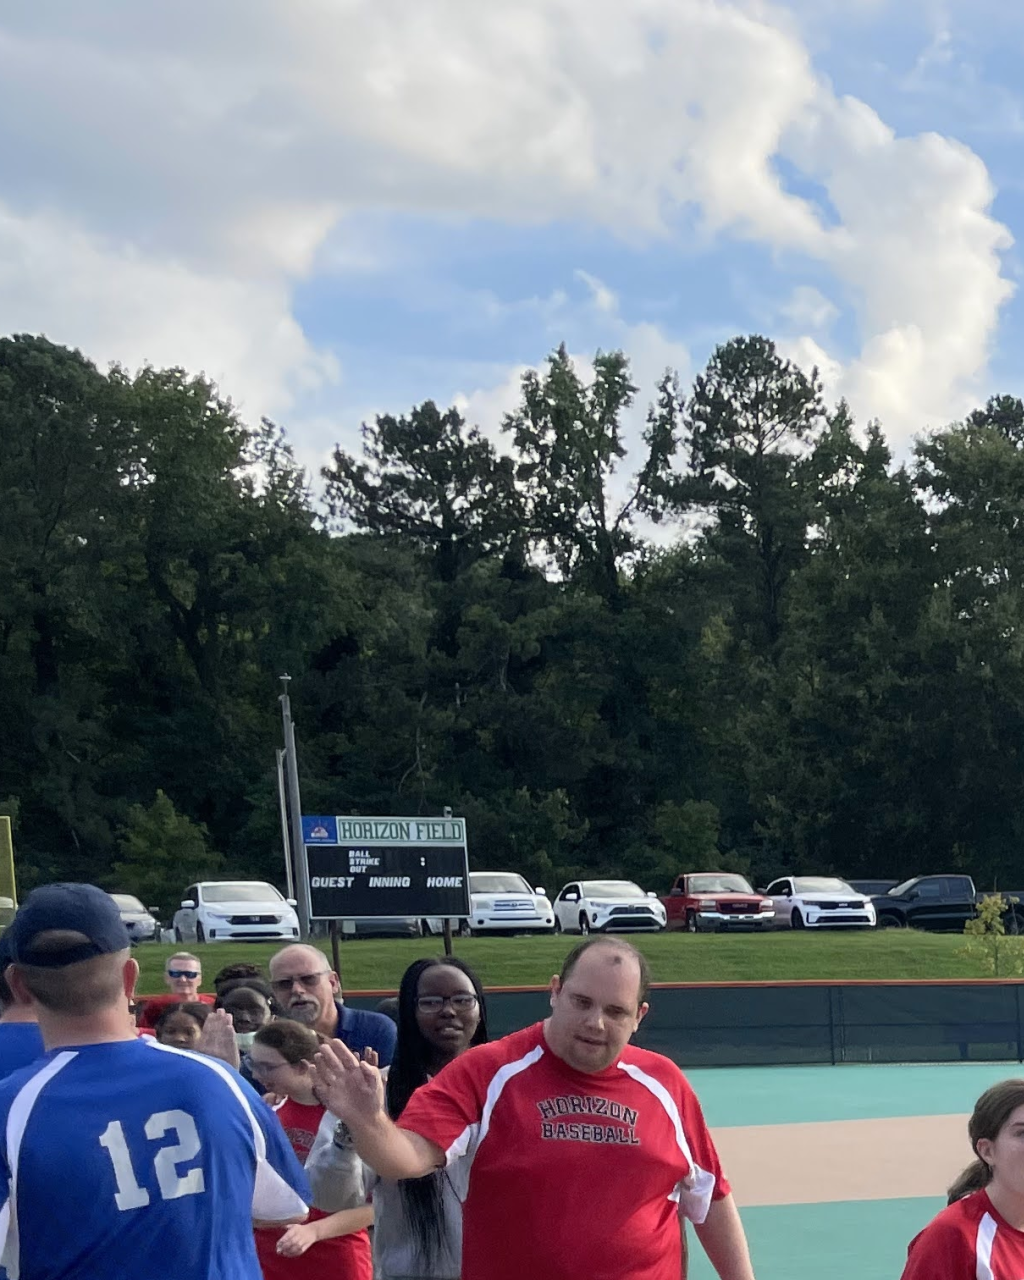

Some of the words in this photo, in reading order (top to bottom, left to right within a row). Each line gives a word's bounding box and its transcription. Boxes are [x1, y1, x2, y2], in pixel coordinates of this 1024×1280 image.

[342, 822, 410, 840] HORIZON
[416, 822, 462, 840] FIELD
[312, 877, 354, 888] GUEST
[369, 877, 410, 887] INNING
[427, 877, 463, 887] HOME
[537, 1094, 639, 1127] HORIZON
[541, 1121, 641, 1146] BASEBALL
[99, 1109, 205, 1211] 12
